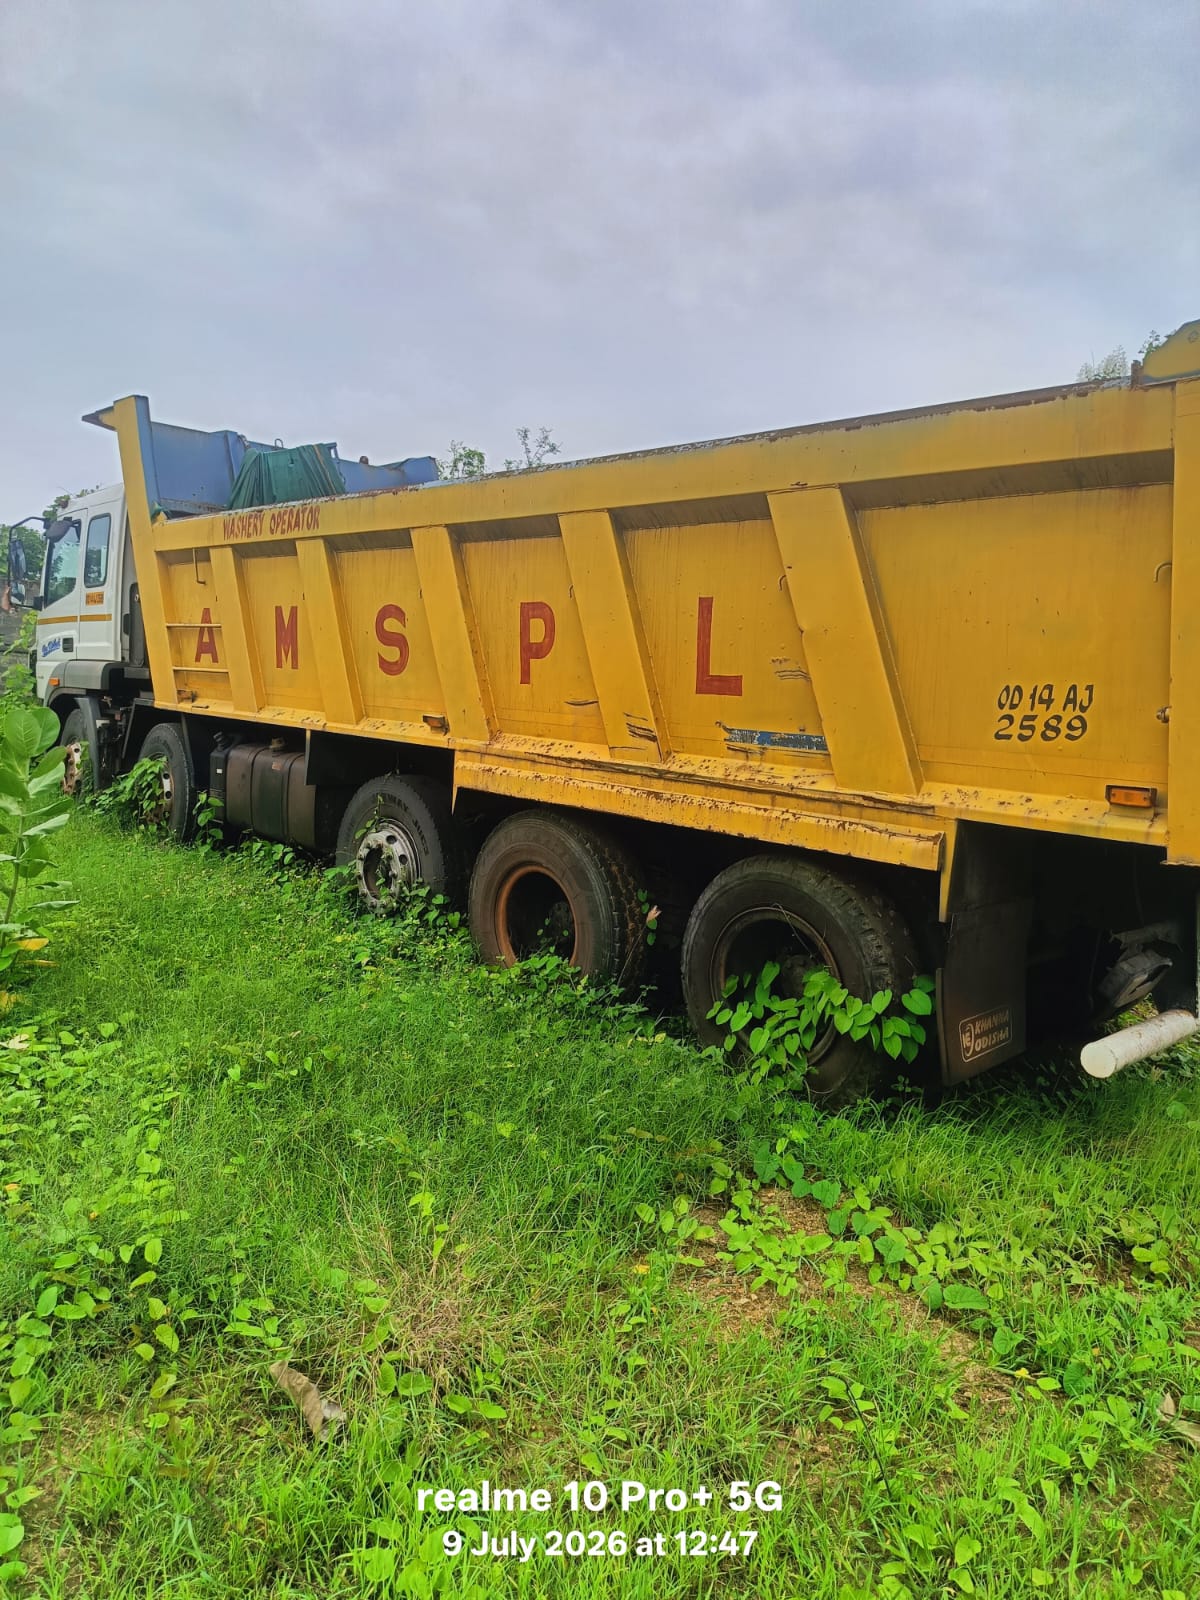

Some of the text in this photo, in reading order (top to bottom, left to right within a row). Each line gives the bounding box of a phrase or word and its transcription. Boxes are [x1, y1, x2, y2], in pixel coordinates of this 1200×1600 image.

[223, 505, 320, 541] WASHERY OPERATOR
[1029, 683, 1055, 712] 14
[1062, 683, 1094, 714] AJ
[994, 713, 1088, 742] 2589
[974, 1027, 1009, 1052] ODISHA
